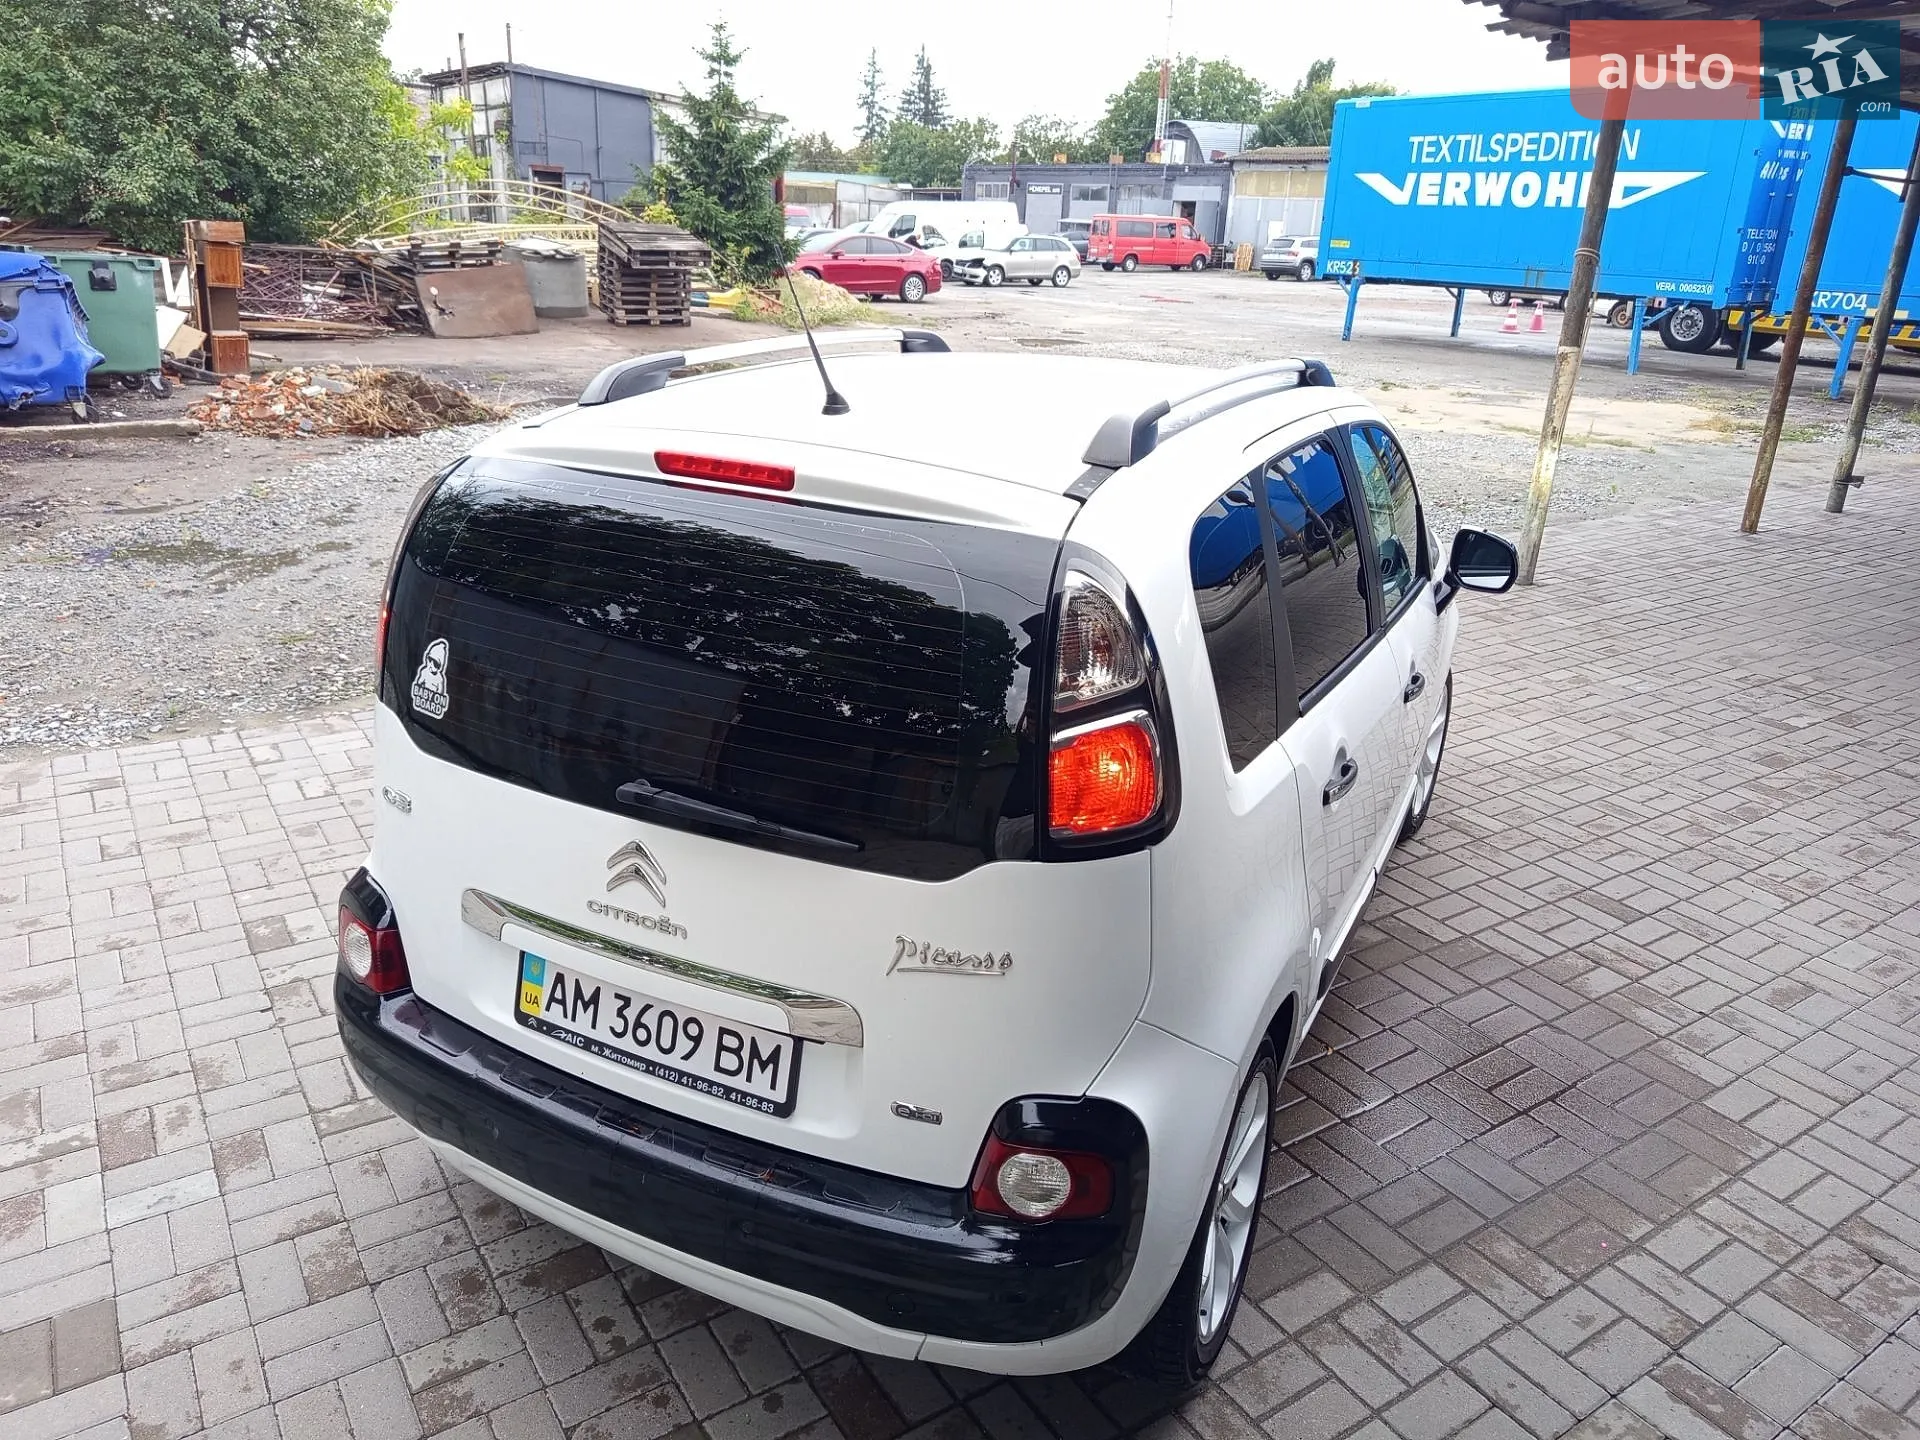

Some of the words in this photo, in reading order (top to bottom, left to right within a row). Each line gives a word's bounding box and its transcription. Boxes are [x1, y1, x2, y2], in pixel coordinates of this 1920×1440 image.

[1407, 128, 1642, 165] TEXTILSPEDITIN
[1655, 281, 1676, 292] VERA
[413, 685, 434, 701] BABY
[434, 693, 447, 707] ON
[415, 696, 442, 714] BOARD
[886, 934, 1013, 976] Picasso
[524, 992, 541, 1008] UA
[544, 971, 603, 1030] AM
[608, 992, 705, 1062] 3609
[713, 1026, 783, 1091] BM
[602, 1046, 647, 1071] Житомир
[655, 1065, 679, 1083] (412)
[681, 1075, 727, 1099] 41-96-82,
[729, 1091, 774, 1114] 41-96-83
